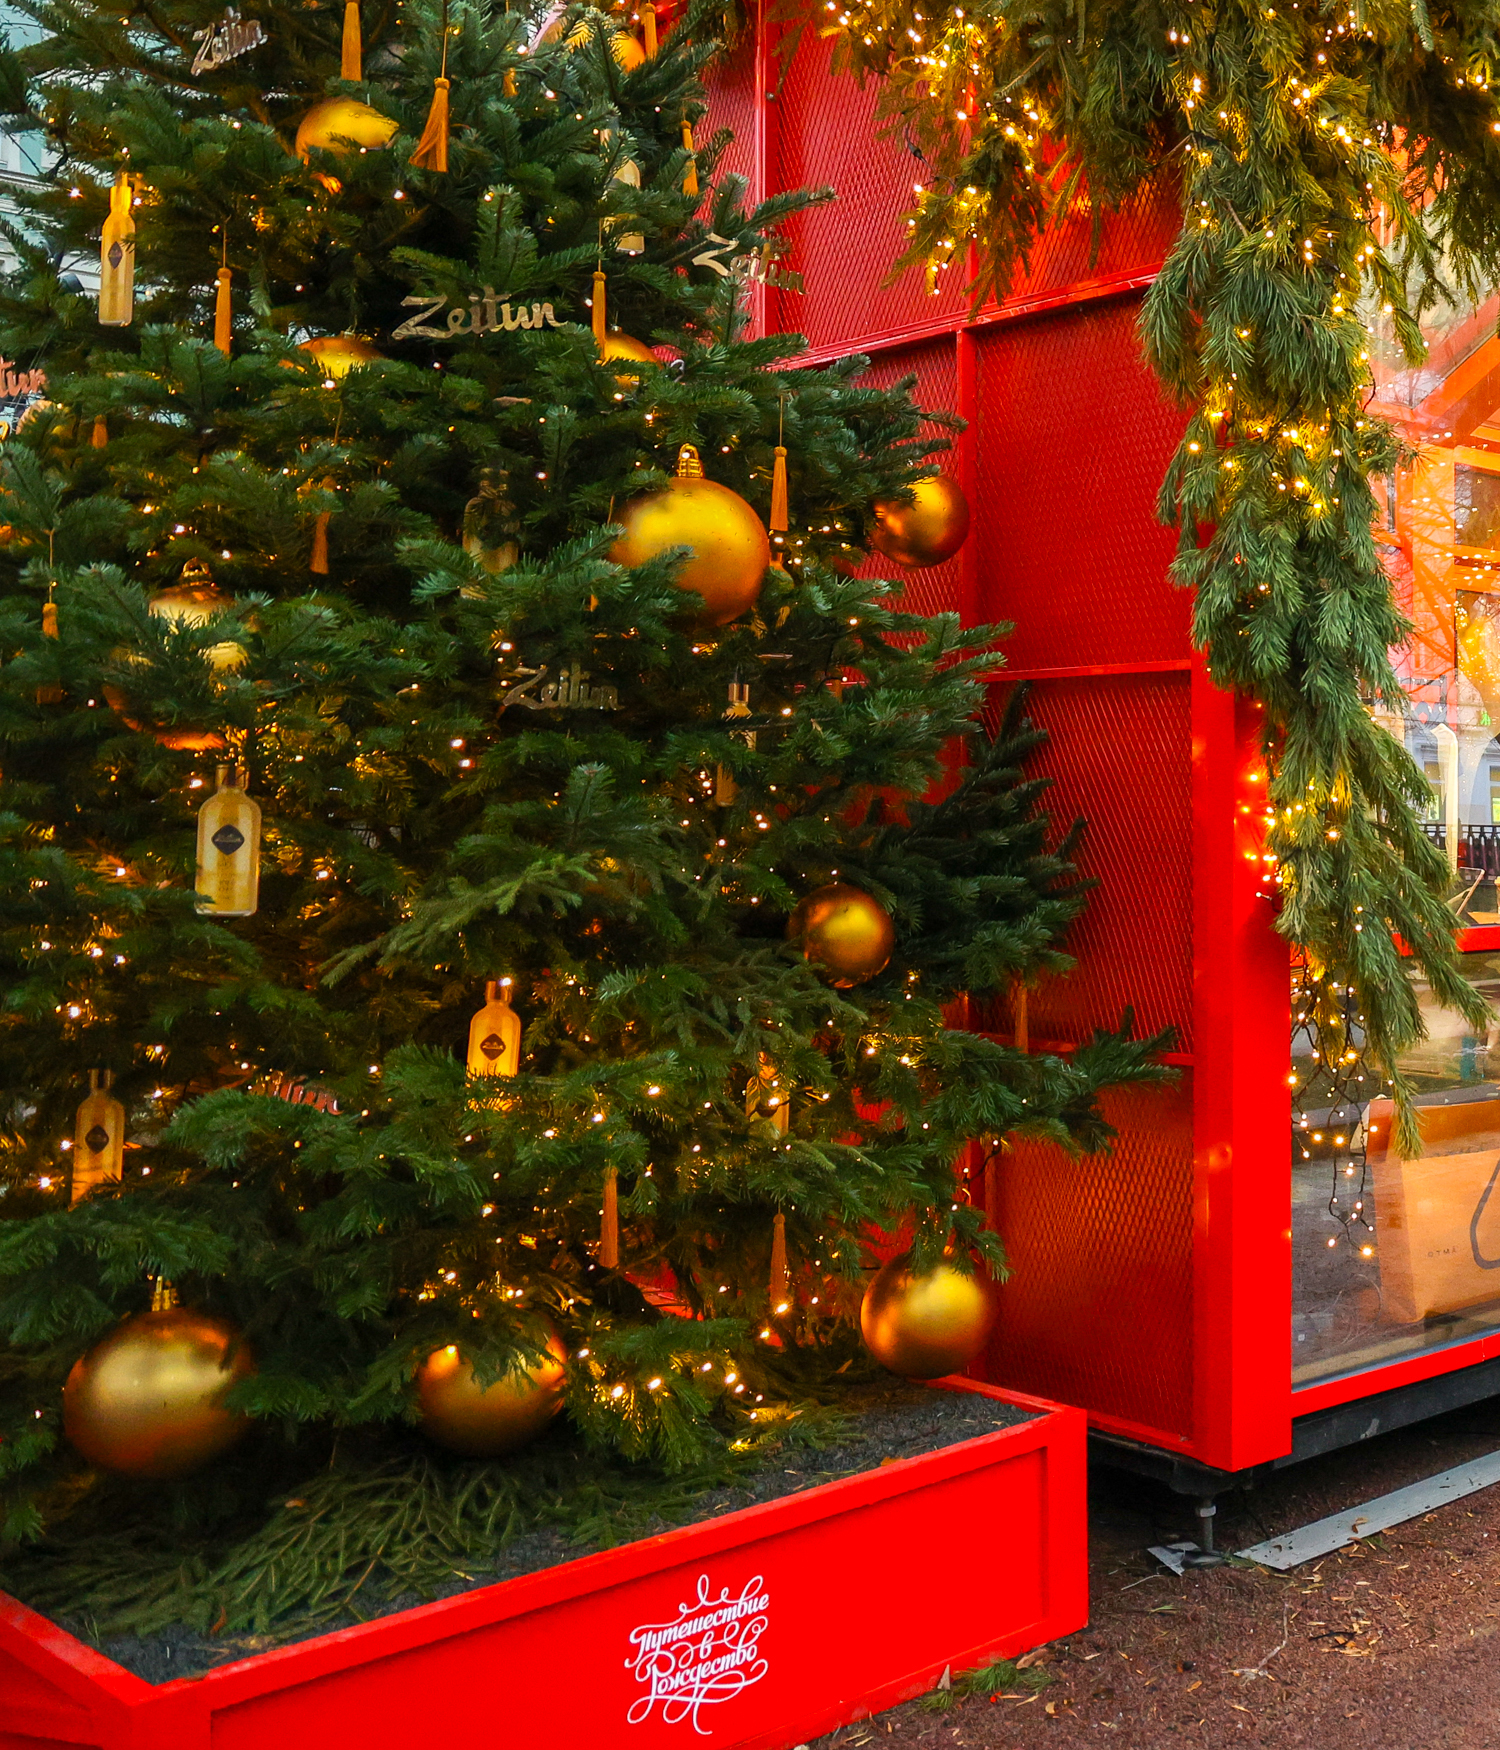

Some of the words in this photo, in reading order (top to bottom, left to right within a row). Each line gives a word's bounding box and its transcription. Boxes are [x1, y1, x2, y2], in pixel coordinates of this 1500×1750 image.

[690, 232, 807, 295] Zeitun
[391, 284, 569, 341] Zeitun
[502, 660, 626, 711] Zeitun
[624, 1580, 770, 1664] Путешествие
[630, 1643, 762, 1724] Рождество
